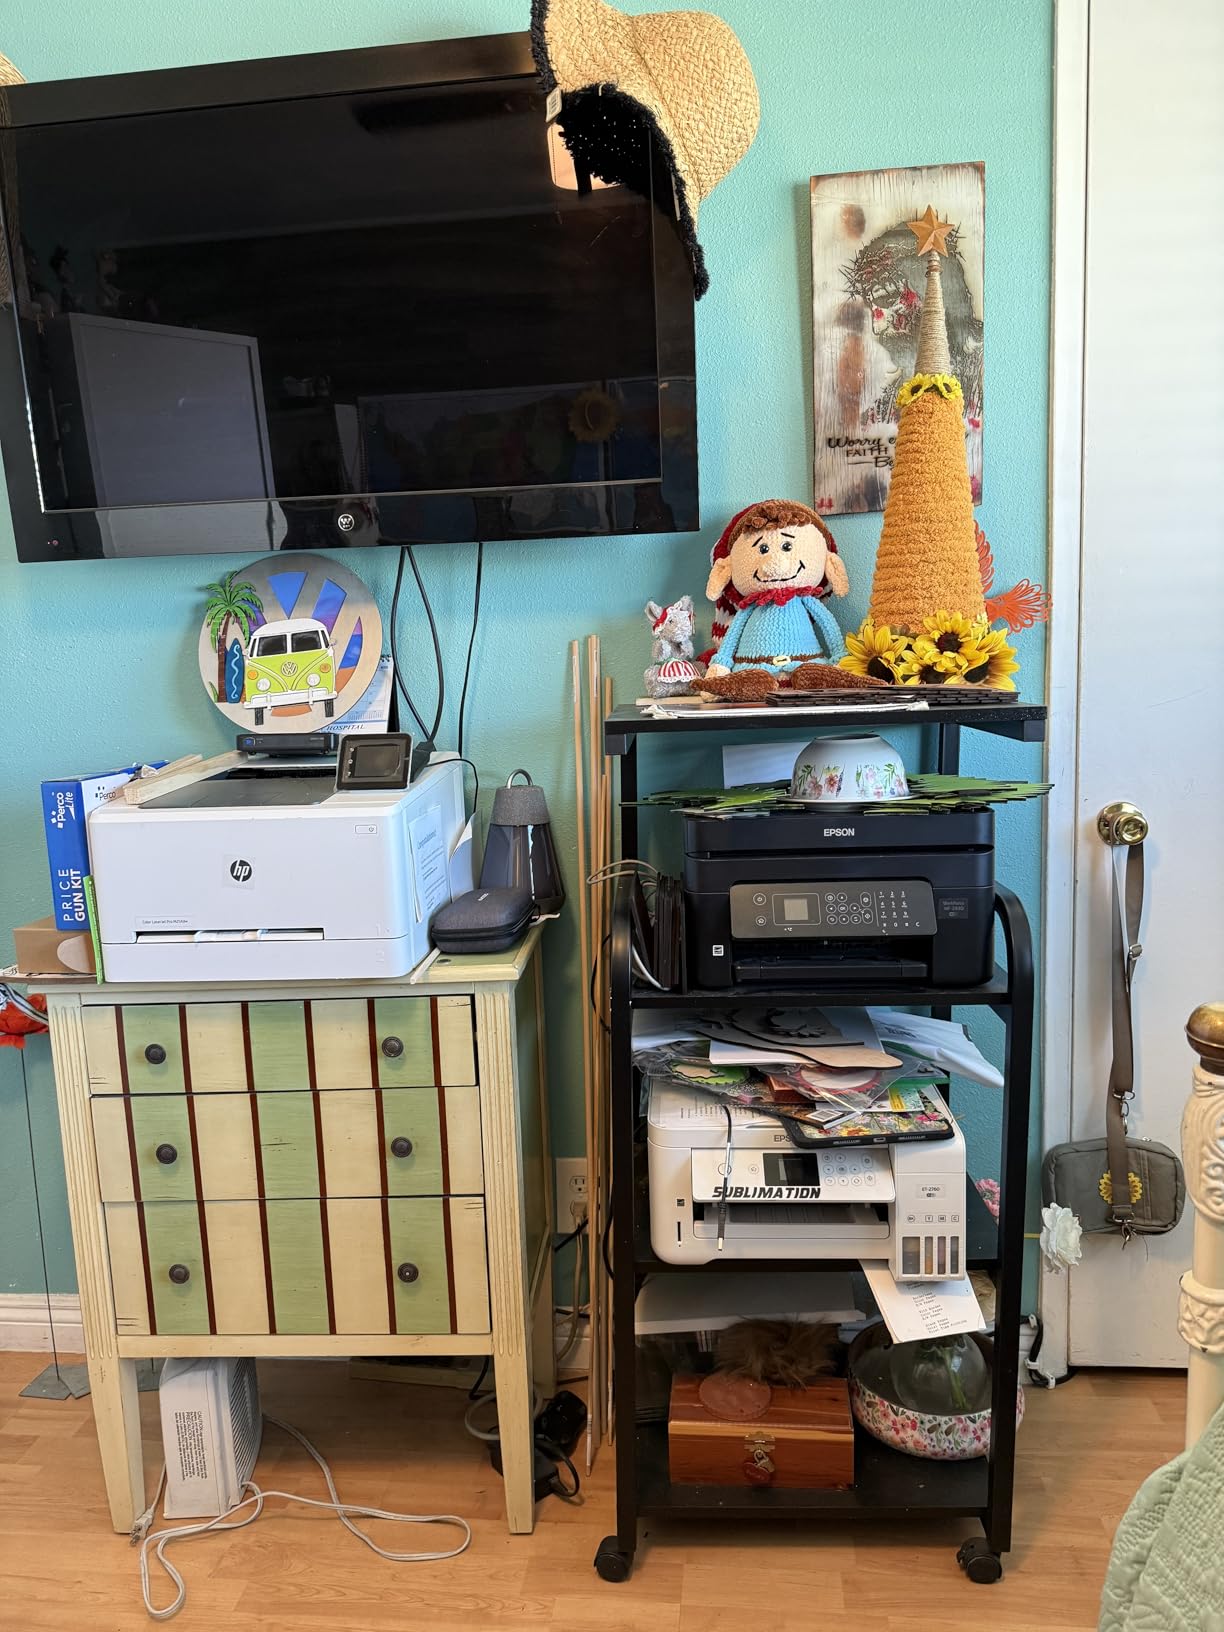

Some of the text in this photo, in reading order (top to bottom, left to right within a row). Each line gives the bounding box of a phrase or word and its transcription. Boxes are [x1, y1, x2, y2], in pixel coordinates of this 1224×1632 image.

[828, 436, 881, 450] Worry
[846, 447, 888, 457] FAITH
[874, 455, 894, 469] Be
[823, 828, 855, 837] EPSON
[230, 859, 252, 882] hp
[58, 869, 74, 921] PRICE
[70, 868, 86, 922] GUN KIT
[774, 1134, 793, 1143] EPS
[711, 1186, 821, 1199] SUBLIMATION
